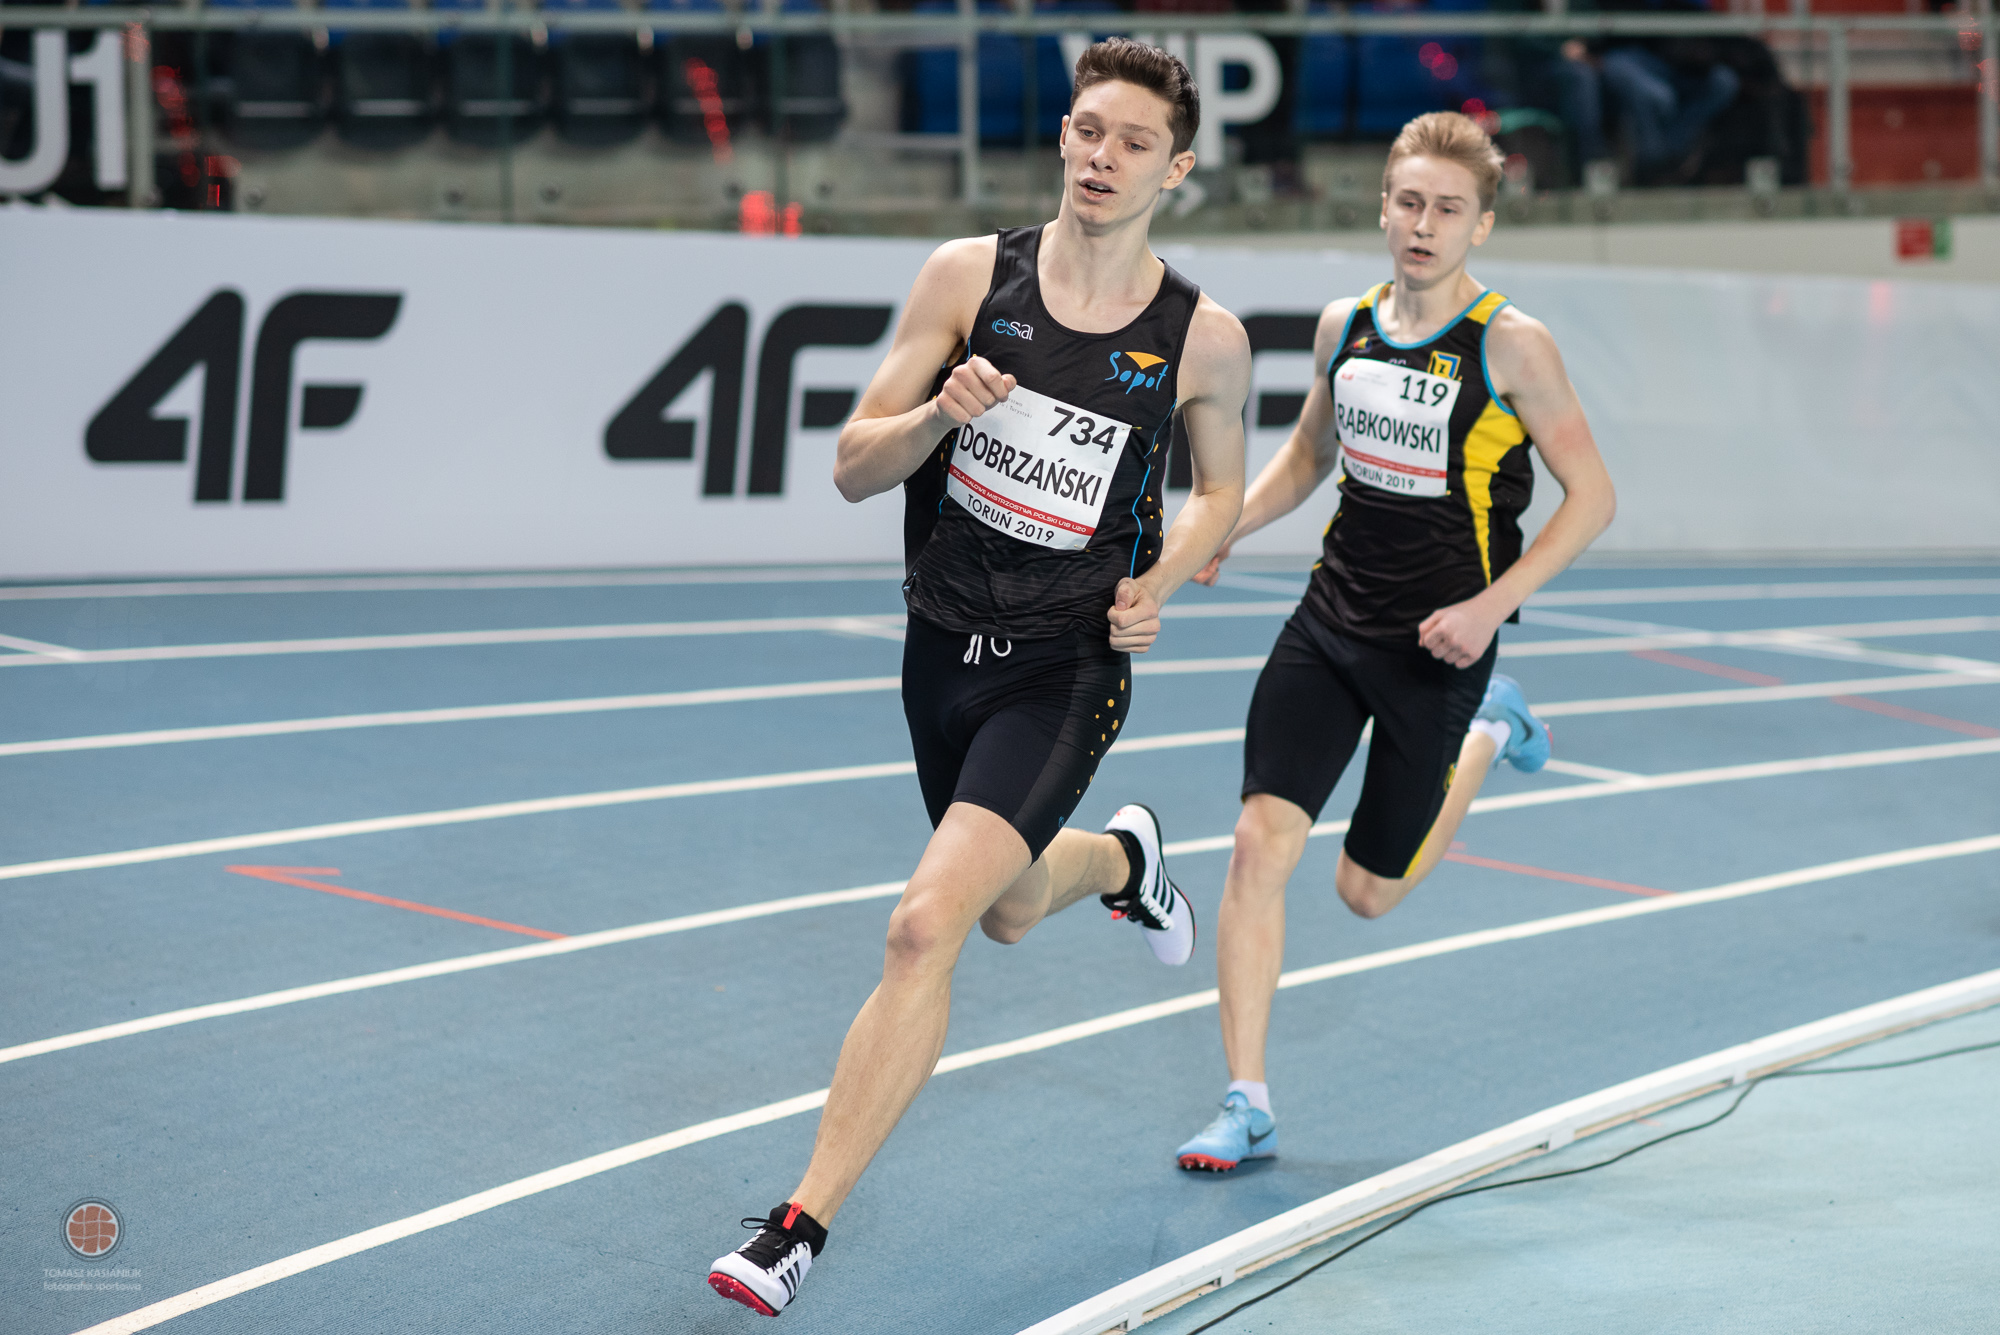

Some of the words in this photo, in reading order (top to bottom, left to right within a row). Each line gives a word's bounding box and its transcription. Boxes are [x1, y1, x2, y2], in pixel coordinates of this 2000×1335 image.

[84, 288, 404, 503] 4F
[604, 301, 894, 496] 4F
[1105, 351, 1168, 395] Sopot
[1399, 374, 1449, 407] 119
[1048, 406, 1117, 454] 734
[1337, 402, 1441, 454] RĄBKOWSKI
[959, 423, 1103, 507] DOBRZAŃSKI
[1352, 462, 1383, 484] TORUŃ
[1385, 473, 1416, 490] 2019
[965, 477, 987, 495] HALOWE
[987, 492, 1033, 516] MISTRZOSTWA
[1033, 511, 1058, 524] POLSKI
[1058, 519, 1071, 529] U18
[1072, 524, 1087, 533] U20
[967, 493, 1013, 530] TORUŃ
[1014, 520, 1055, 543] 2019
